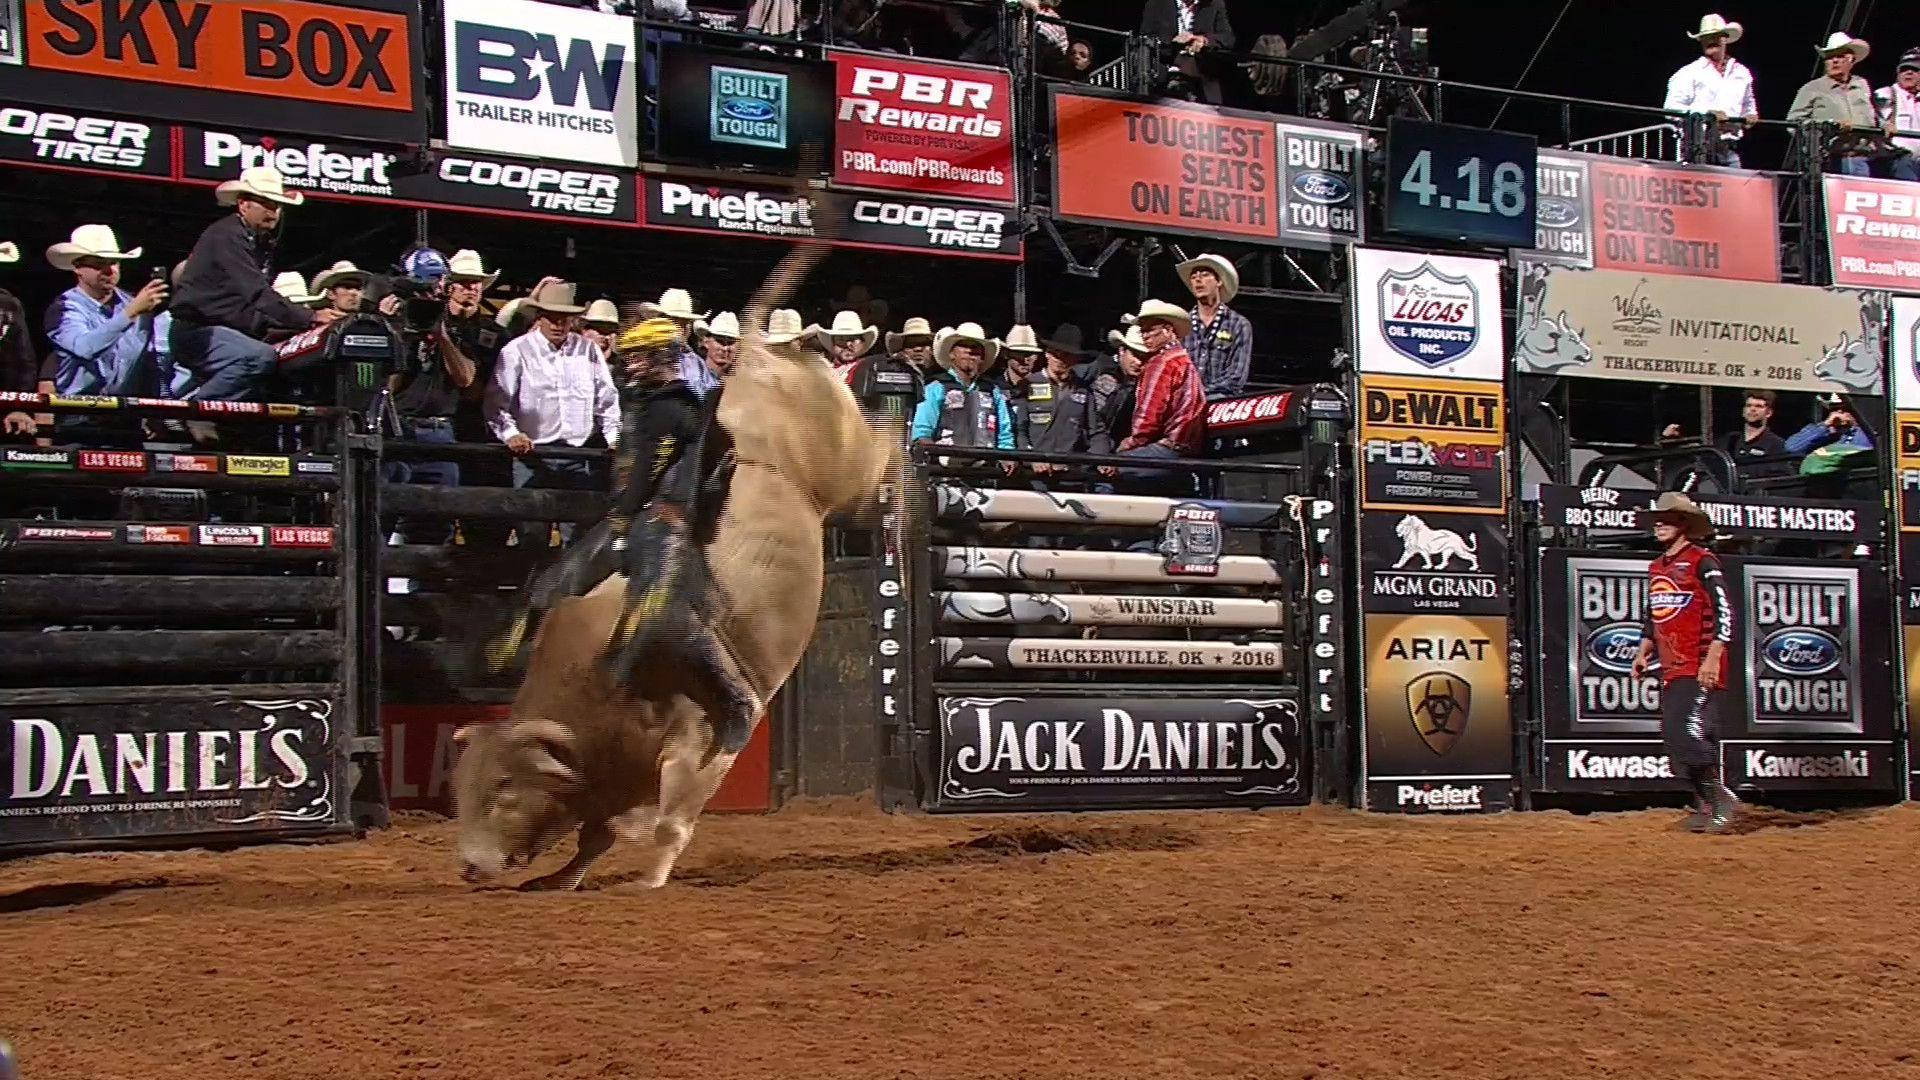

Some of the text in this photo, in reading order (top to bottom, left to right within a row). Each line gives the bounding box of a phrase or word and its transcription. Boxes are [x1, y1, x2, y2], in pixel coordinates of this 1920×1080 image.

[44, 0, 396, 93] SKY BOX
[721, 76, 778, 100] BUILT
[851, 66, 994, 109] PBR
[456, 100, 614, 135] TRAILER HITCHES
[733, 101, 764, 116] Ford
[838, 97, 1002, 138] Rewards
[719, 117, 778, 139] TOUGH
[1124, 111, 1265, 159] TOUGHEST
[32, 136, 146, 168] TIRES
[204, 131, 390, 186] Priefert
[1287, 137, 1354, 173] BUILT
[438, 158, 621, 199] COOPER
[842, 150, 1004, 186] PBR.com/PBRewards
[1181, 153, 1266, 192] SEATS
[282, 176, 393, 196] anch Equipment
[1304, 176, 1338, 197] Ford
[1400, 150, 1526, 217] 4.18
[1537, 167, 1580, 198] UILT
[1601, 170, 1722, 209] TOUGHEST
[527, 190, 617, 215] TIRES
[661, 182, 812, 227] Priefert
[1131, 181, 1266, 226] ON EARTH
[1844, 190, 1920, 217] PB
[718, 218, 815, 236] Ranch Equipment
[853, 199, 1006, 234] COOPER
[1289, 203, 1354, 231] TOUGH
[1602, 201, 1675, 236] SEATS
[927, 226, 1002, 250] TIRES
[1536, 229, 1584, 253] OUGH
[1605, 232, 1720, 270] ON EARTH
[1393, 299, 1469, 323] LUCAS
[1388, 325, 1472, 342] OIL PRODUCTS
[1670, 318, 1800, 346] INVITATIONAL
[1419, 343, 1444, 355] INC.
[1603, 355, 1802, 381] THACKERVILLE, OK 2016
[203, 401, 224, 411] LAS
[1254, 395, 1284, 418] OIL
[7, 450, 68, 462] Kawasaki
[83, 453, 105, 466] LAS
[107, 454, 143, 468] VEGAS
[230, 457, 287, 473] Wrangler
[1580, 487, 1621, 506] HEINZ
[1173, 509, 1216, 521] PBR
[1565, 508, 1637, 528] BBQ SAUCE
[1701, 502, 1857, 532] WITH THE MASTERS
[205, 527, 250, 535] LINCOLN
[275, 529, 330, 544] LAS VEGAS
[1373, 576, 1496, 598] MGM GRAND
[1582, 577, 1648, 621] BUI
[1116, 599, 1216, 616] WINSTAR
[1312, 500, 1335, 712] Priefert
[1413, 599, 1460, 608] LAS VEGAS
[1757, 583, 1846, 626] BUILT
[1131, 615, 1203, 626] INVITATIONAL
[1023, 648, 1275, 670] THACKERVILLE, OK 2016
[1385, 637, 1491, 661] ARIAT
[1605, 634, 1639, 660] For
[1779, 639, 1823, 664] Ford
[1582, 676, 1661, 711] TOUG
[1758, 678, 1848, 713] TOUGH
[957, 707, 1287, 773] JACK DANIEL'S
[10, 714, 309, 799] DANIEL'S
[391, 723, 457, 798] LA
[1568, 750, 1676, 779] Kawasa
[1746, 749, 1868, 778] Kawasaki
[1398, 784, 1481, 805] Priefert
[0, 807, 41, 817] ANIEL'S
[91, 803, 115, 812] YOU
[119, 803, 133, 811] TO
[135, 801, 171, 811] DRINK
